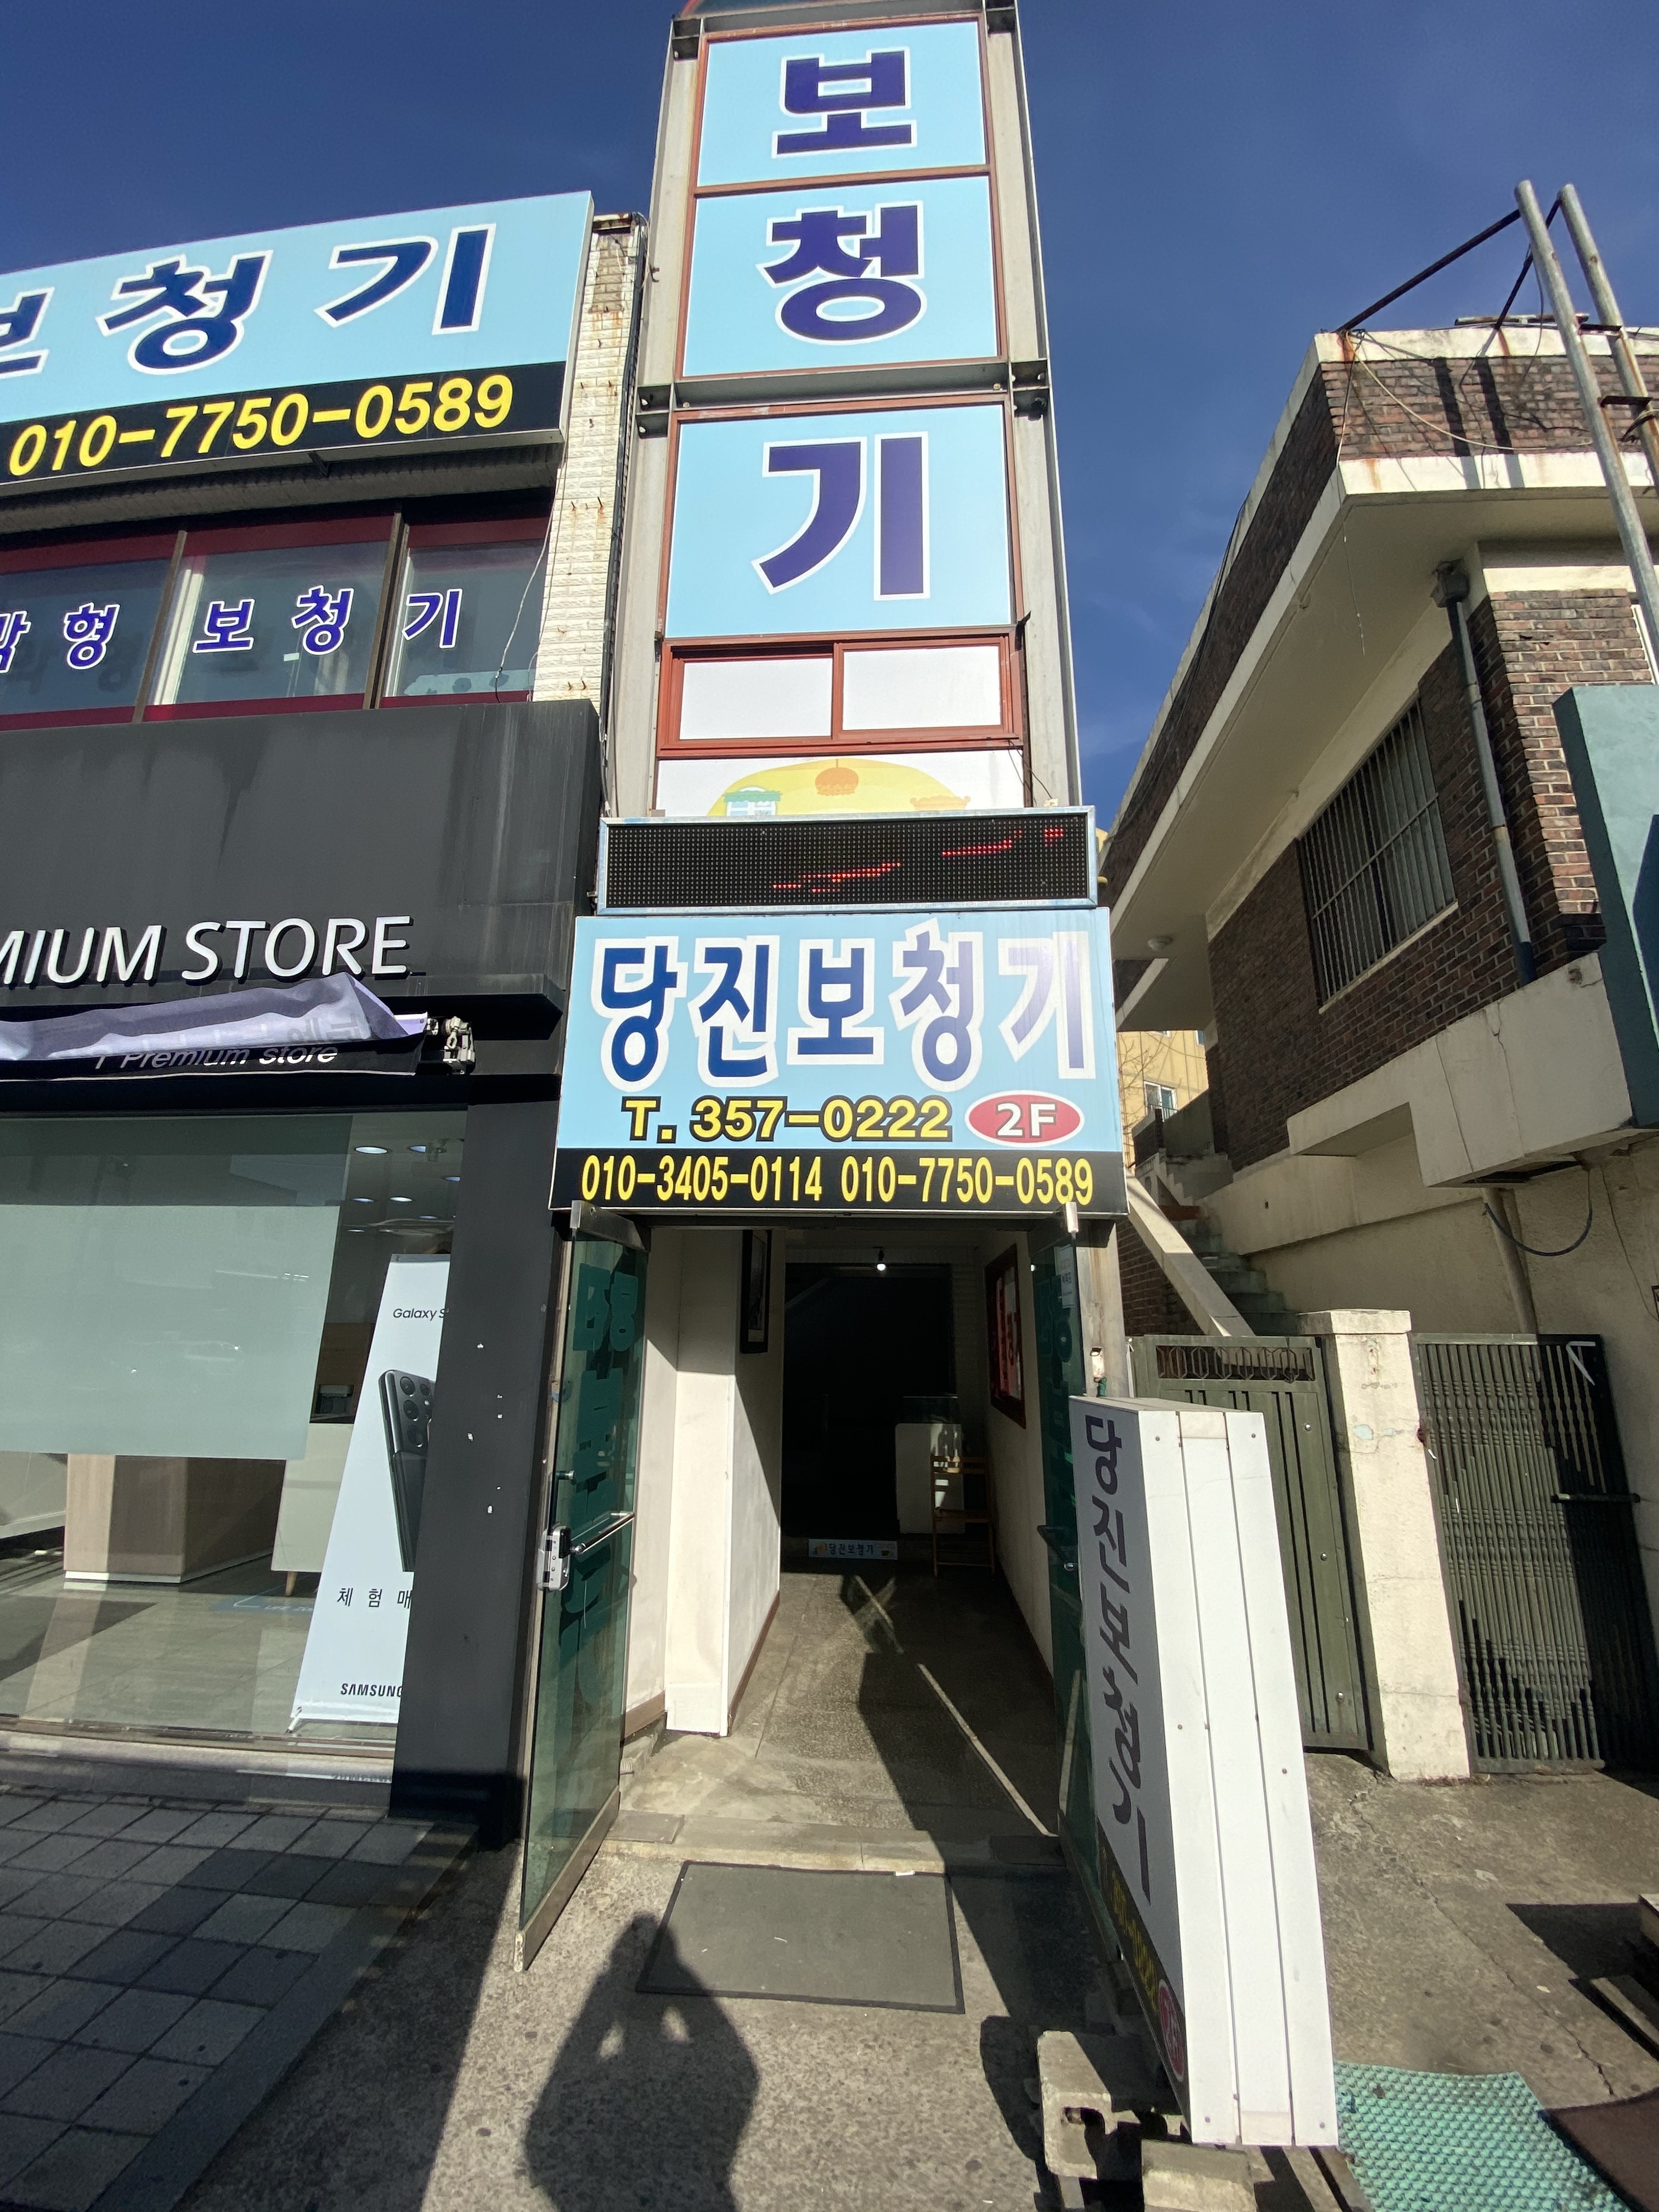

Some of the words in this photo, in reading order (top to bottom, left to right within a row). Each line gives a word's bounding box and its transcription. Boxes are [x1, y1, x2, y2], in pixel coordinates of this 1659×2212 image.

[752, 47, 929, 601] 보청기
[9, 374, 514, 476] 010-7750-0589
[192, 585, 463, 654] 보청기
[182, 916, 411, 980] STORE
[591, 918, 1096, 1091] 당진보청기
[120, 1047, 250, 1069] Premium
[259, 1045, 338, 1064] store
[622, 1095, 676, 1143] T.
[690, 1095, 953, 1142] 357-0222
[994, 1101, 1059, 1138] 2F
[581, 1154, 822, 1201] 010-3405-0114
[840, 1156, 1093, 1205] 010-7750-0589
[393, 1308, 437, 1321] Galaxy
[1085, 1413, 1151, 1906] 당진보청기
